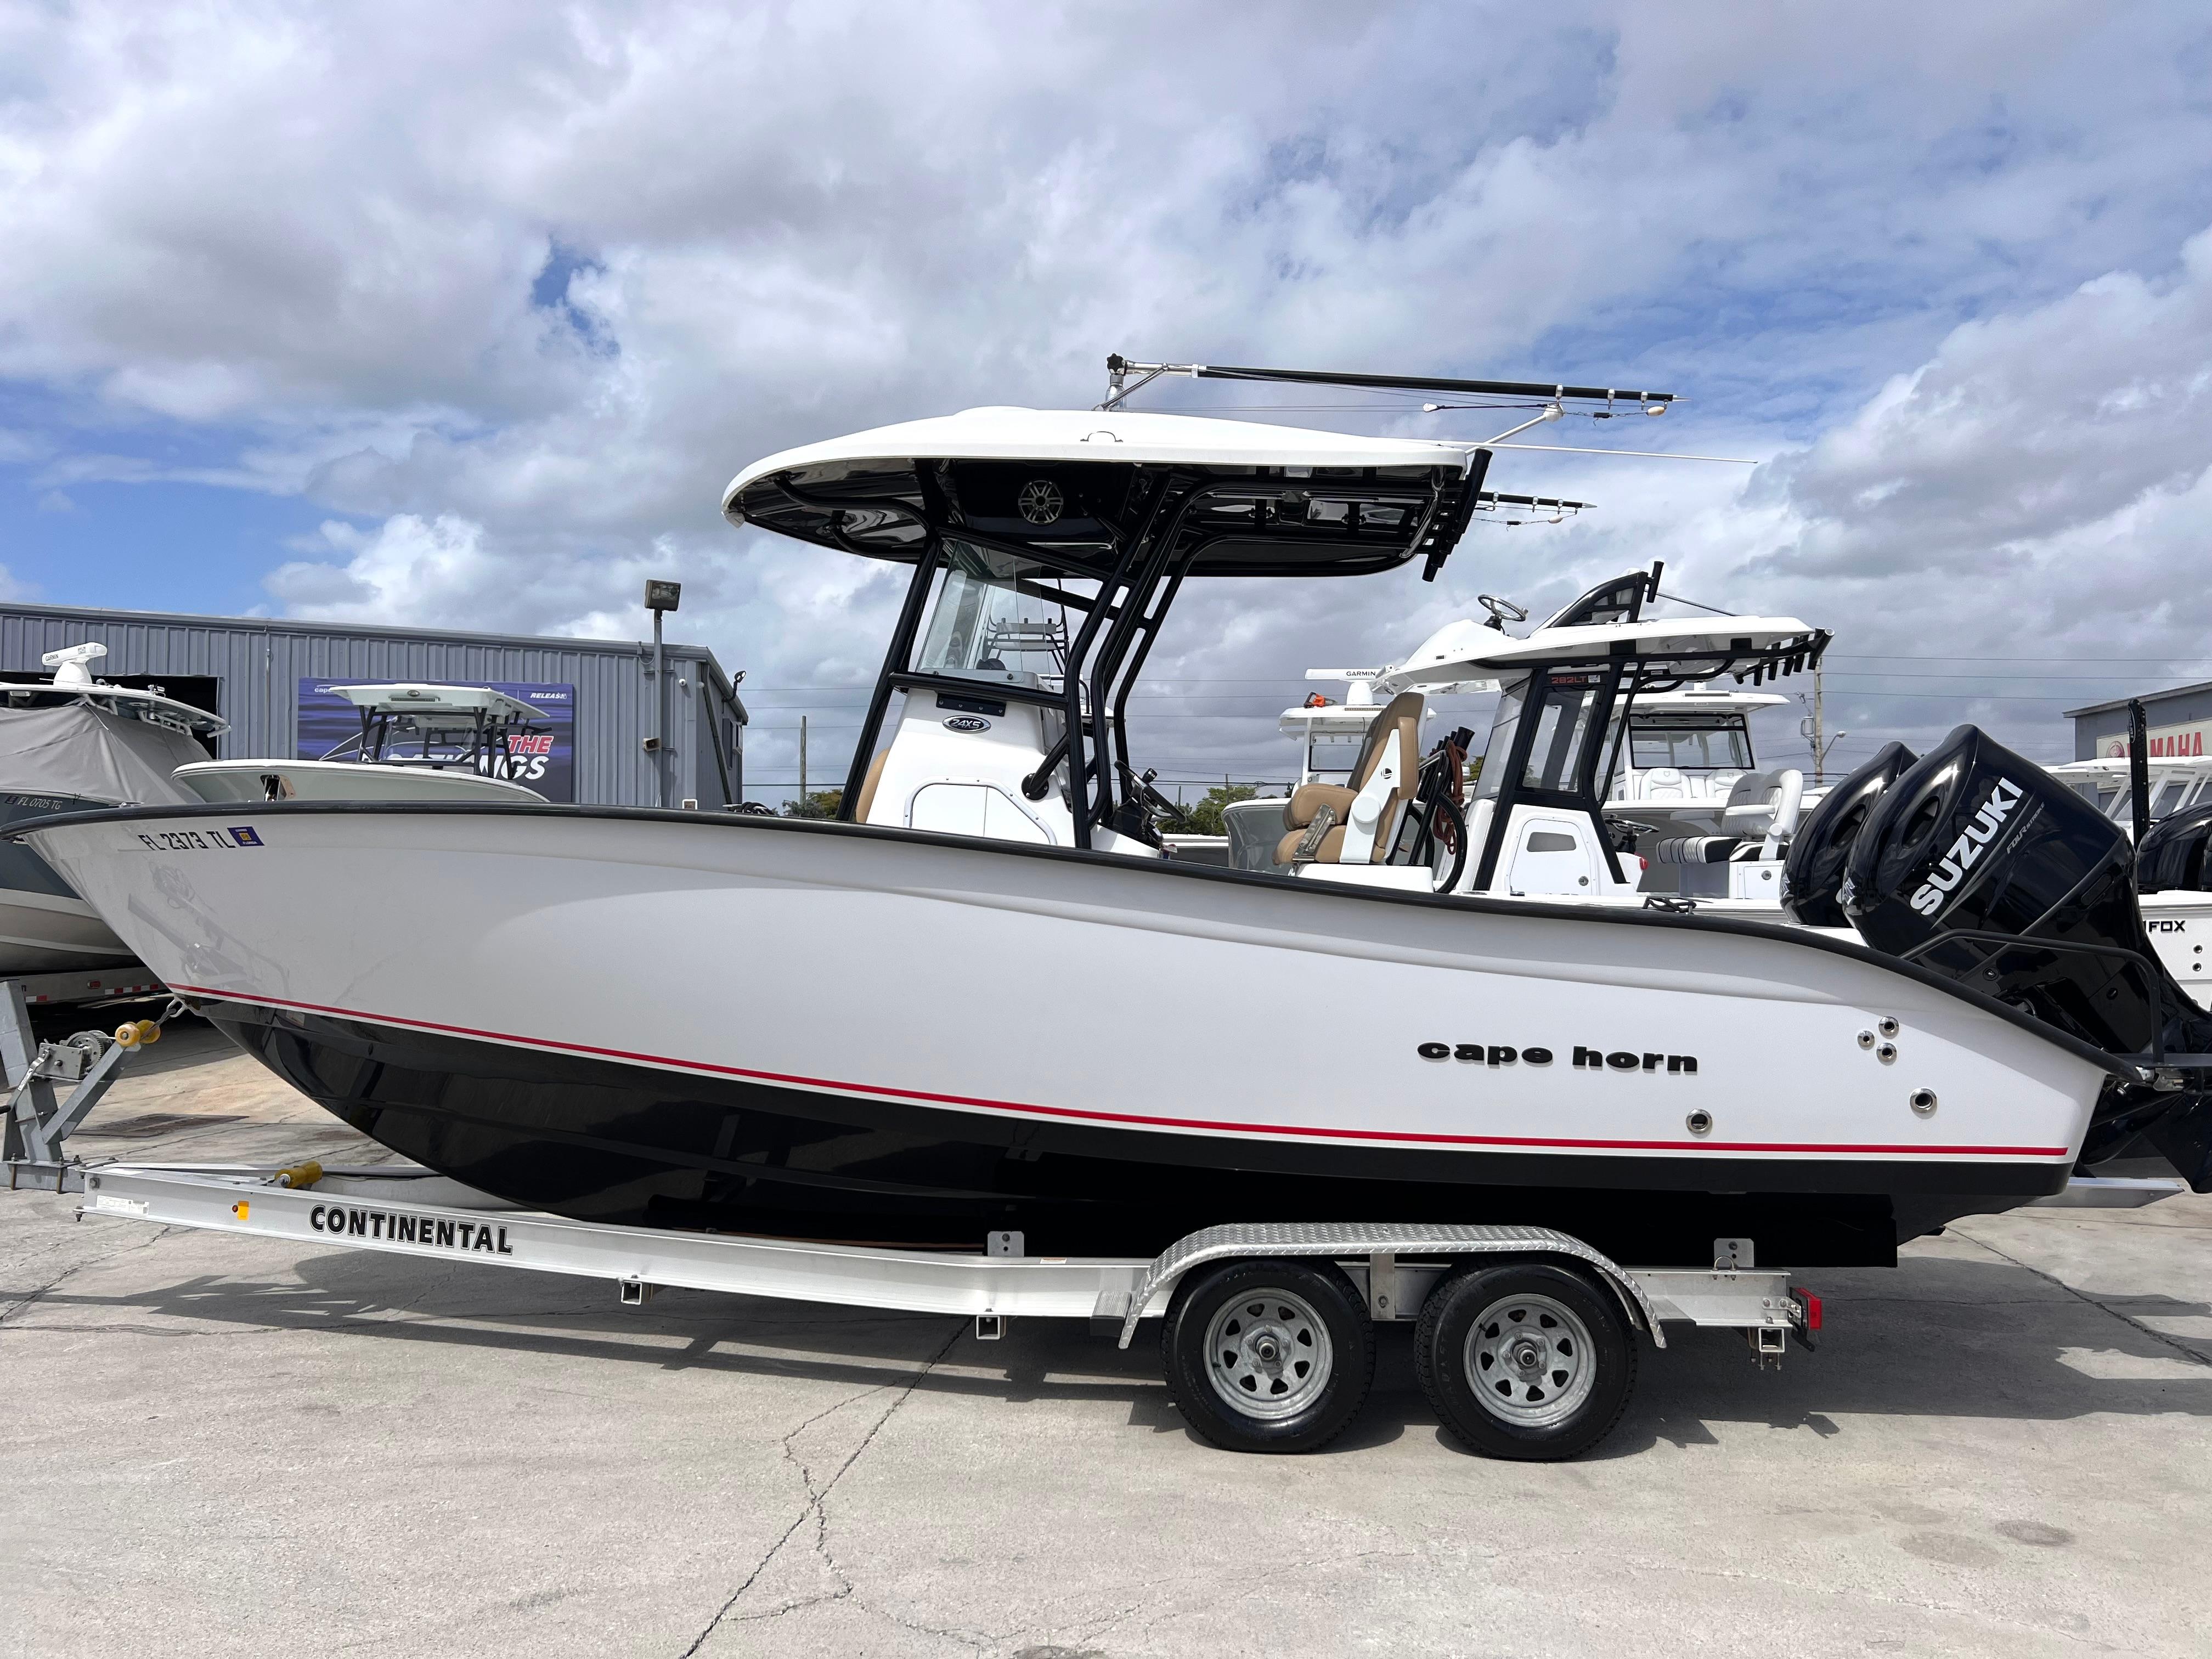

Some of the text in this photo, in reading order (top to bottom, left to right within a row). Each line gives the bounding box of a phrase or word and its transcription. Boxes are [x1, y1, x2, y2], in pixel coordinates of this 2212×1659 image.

[1551, 676, 1587, 684] 282LT
[507, 735, 554, 754] THE
[2127, 731, 2203, 757] MAHA
[18, 797, 29, 806] FL
[29, 798, 52, 809] 0705
[51, 800, 63, 810] TG
[138, 834, 167, 850] FL
[160, 832, 210, 850] 2373
[206, 831, 236, 848] TL
[1910, 777, 2023, 915] SUZUKI
[1418, 1042, 1698, 1072] cape horn
[310, 1204, 513, 1255] CONTINENTAL
